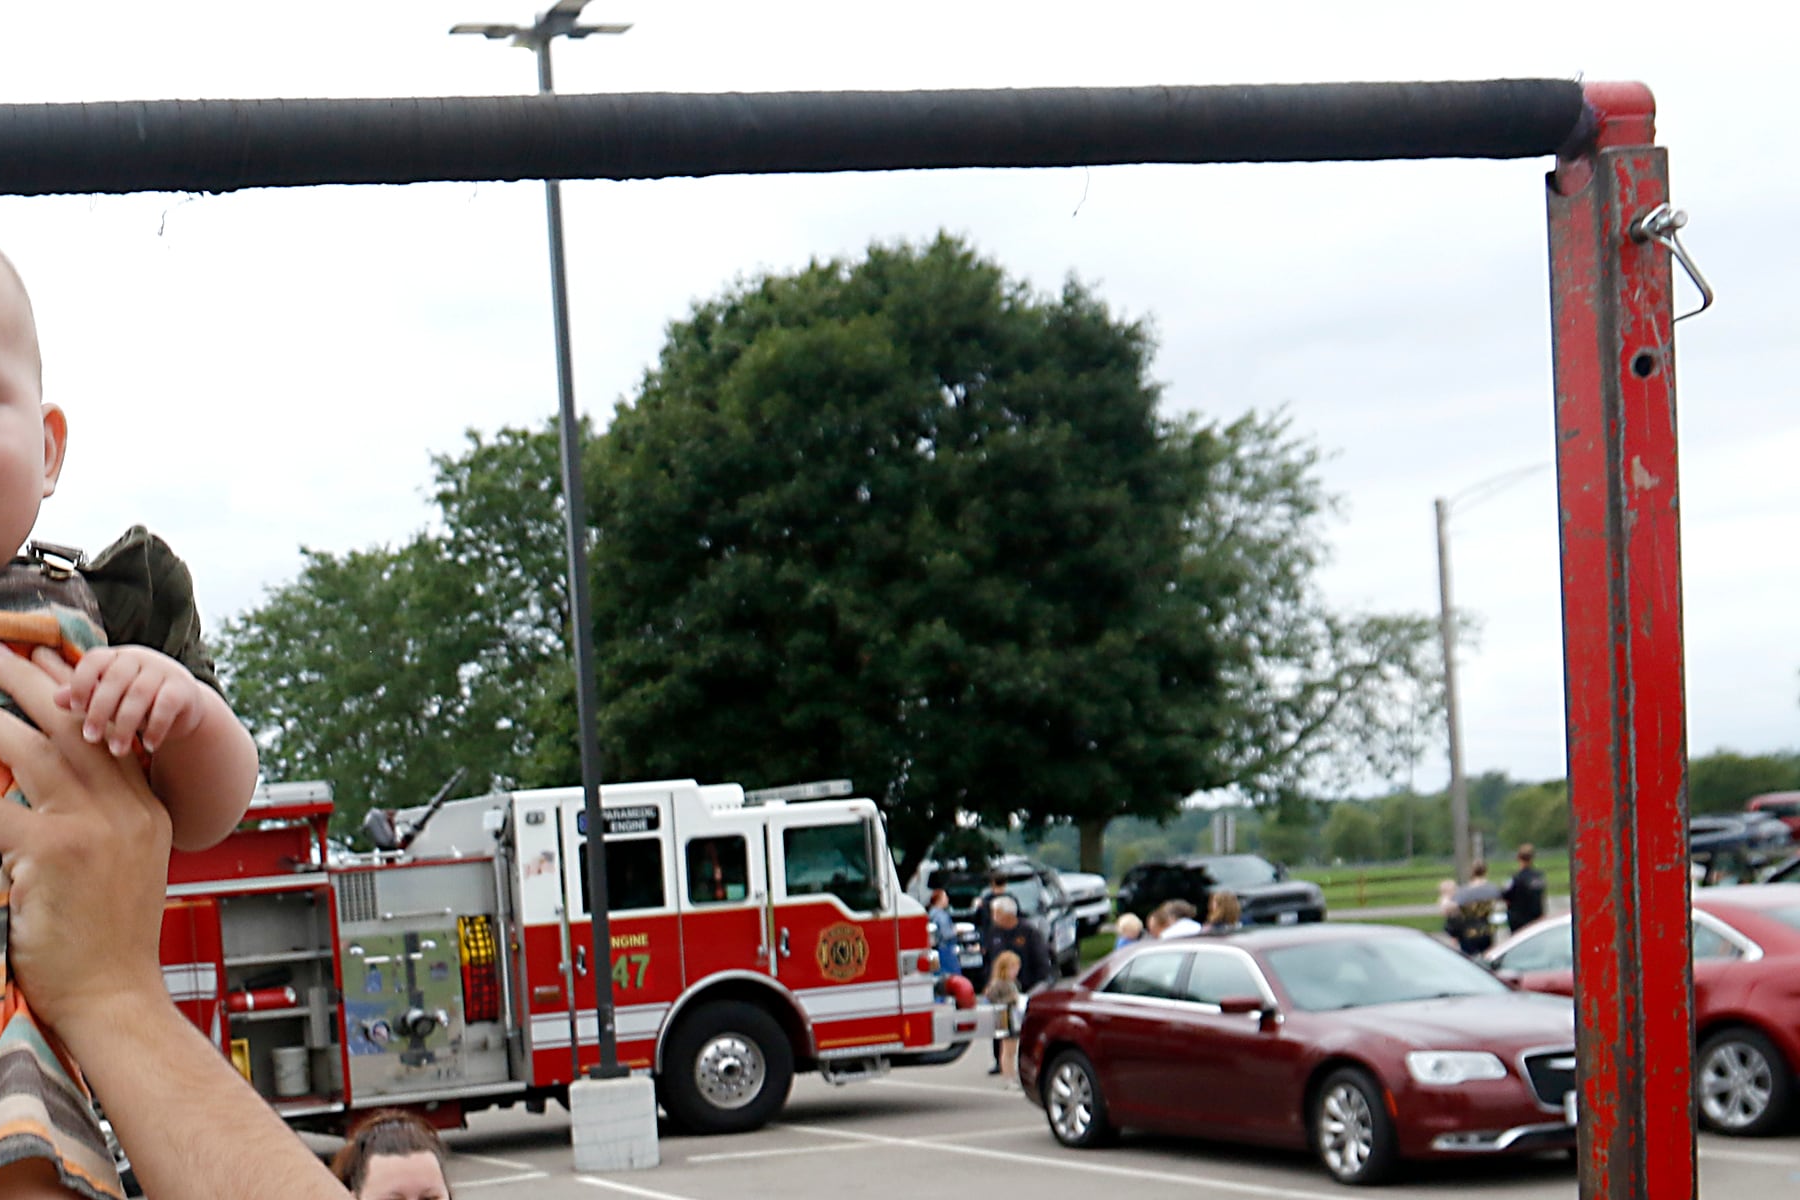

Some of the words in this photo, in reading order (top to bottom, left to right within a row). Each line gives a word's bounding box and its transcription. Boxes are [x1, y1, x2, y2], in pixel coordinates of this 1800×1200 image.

[610, 819, 648, 834] ENGINE
[611, 932, 649, 949] NGINE
[611, 953, 650, 989] 47
